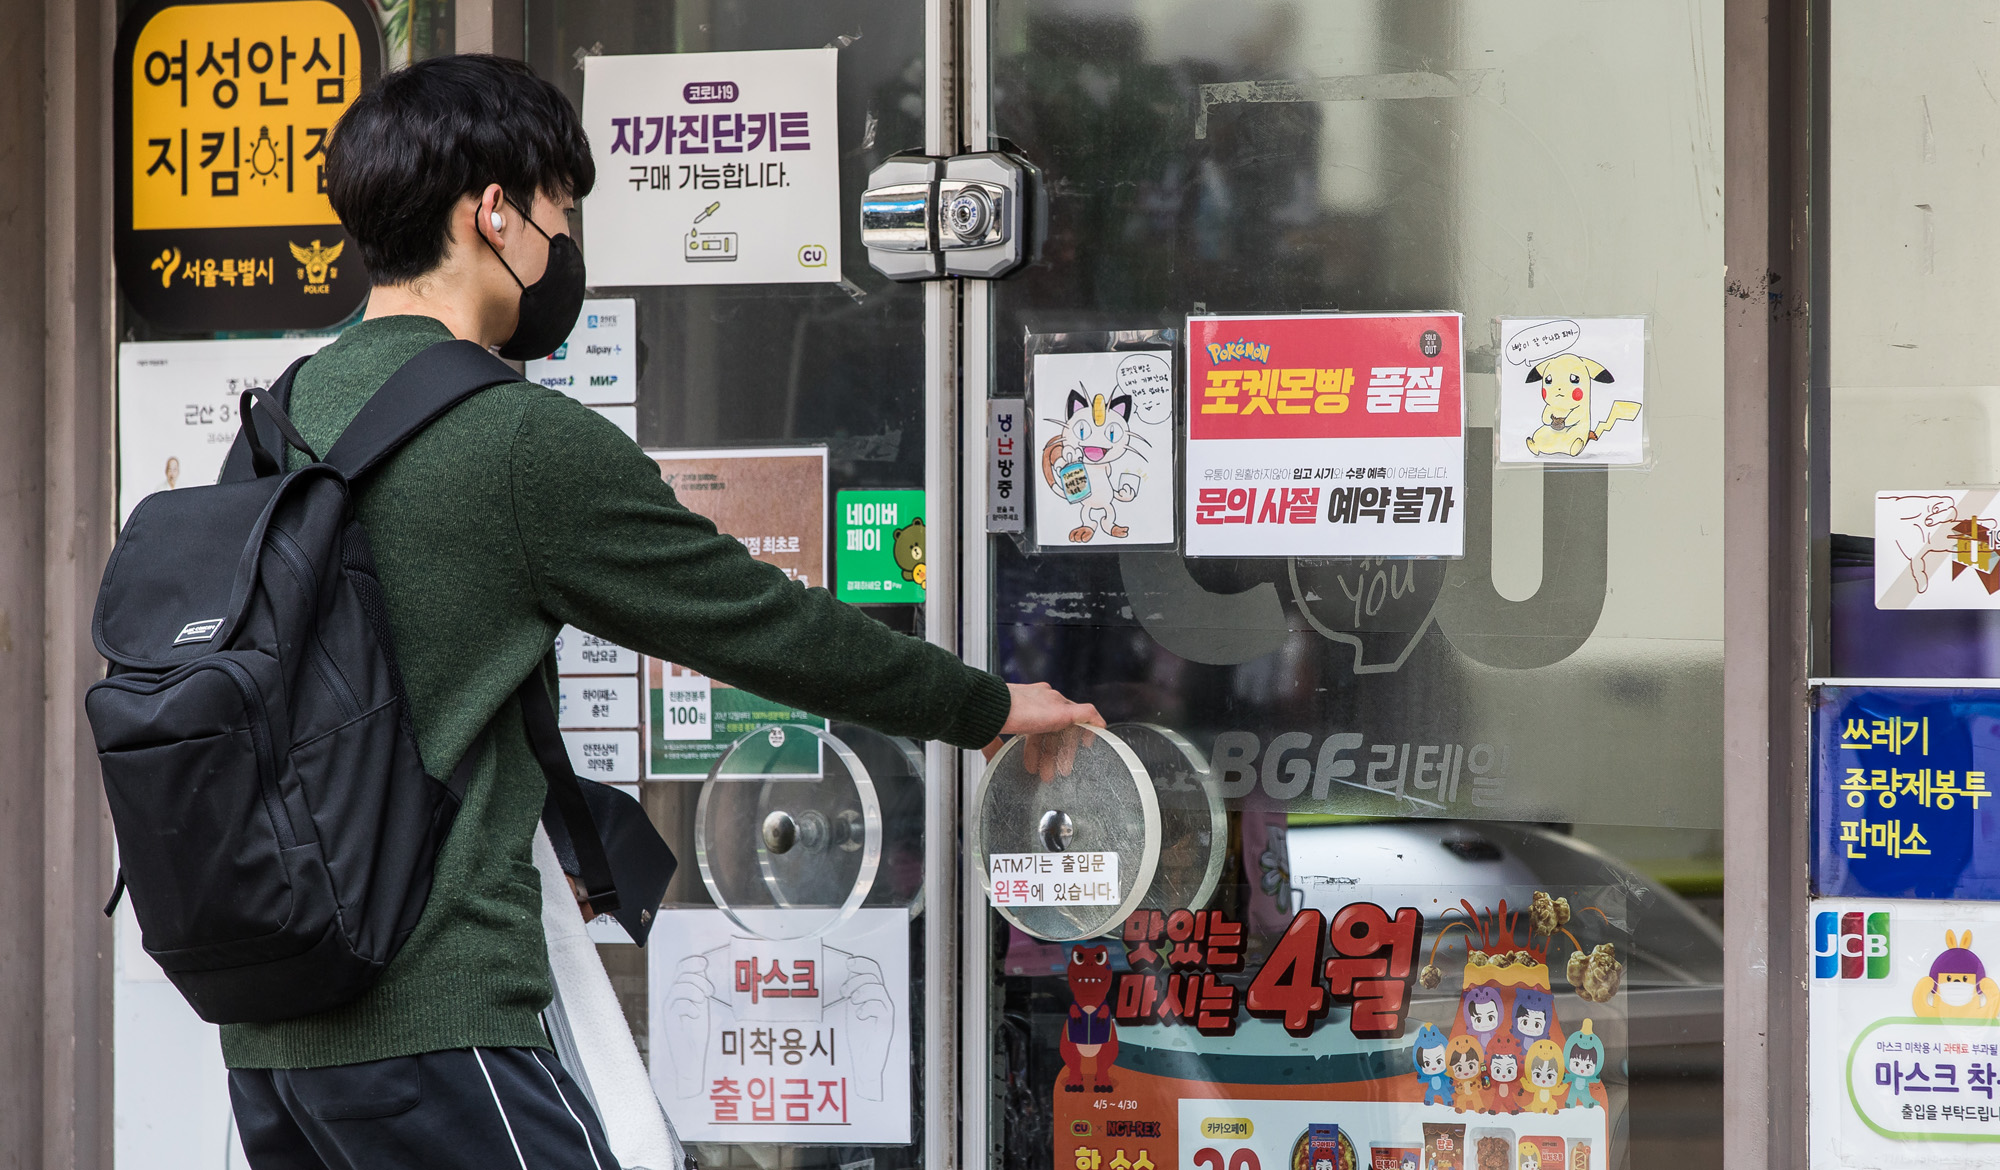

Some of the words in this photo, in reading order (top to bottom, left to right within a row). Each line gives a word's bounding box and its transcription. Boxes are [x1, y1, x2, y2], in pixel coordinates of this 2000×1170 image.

[145, 33, 345, 109] 여성안심
[689, 85, 735, 100] 코로나19
[611, 112, 811, 155] 자가진단키트
[629, 165, 671, 191] 구매
[679, 162, 790, 190] 가능합니다.
[803, 250, 822, 262] CU
[182, 257, 274, 288] 서울특별시
[304, 284, 330, 294] POLICE
[1425, 345, 1437, 355] OUT
[1511, 341, 1529, 352] 빵이
[1201, 368, 1355, 415] 포켓몬빵
[1366, 366, 1443, 414] 품절
[1204, 468, 1233, 480] 유통이
[1234, 468, 1291, 480] 원활하지않아
[1293, 468, 1313, 480] 입고
[1314, 468, 1344, 480] 시기와
[1345, 468, 1365, 480] 수량
[1367, 468, 1396, 480] 예측이
[1398, 467, 1448, 479] 어렵습니다.
[847, 503, 897, 526] 네이버
[1196, 488, 1257, 524] 문의
[1257, 487, 1320, 524] 사절
[1328, 487, 1392, 524] 예약
[1393, 487, 1455, 524] 불가
[763, 536, 800, 554] 최초로
[847, 529, 880, 551] 페이
[582, 651, 618, 662] 미납요금
[583, 690, 618, 701] 하이패스
[592, 705, 609, 717] 충전
[669, 706, 706, 725] 100원
[1841, 716, 1928, 755] 쓰레기
[583, 744, 619, 756] 안전상비
[587, 759, 614, 771] 의약품
[1840, 767, 1992, 810] 종량제봉투
[1840, 818, 1931, 858] 판매소
[992, 855, 1053, 874] ATM기는
[1061, 854, 1106, 873] 출입문
[994, 880, 1044, 903] 왼쪽에
[1053, 882, 1115, 902] 있습니다.
[1123, 909, 1242, 965] 맛있는
[1815, 934, 1888, 958] JCB
[1247, 903, 1418, 1032] 4월
[735, 956, 819, 1005] 마스크
[1116, 973, 1234, 1029] 마시는
[721, 1027, 835, 1066] 미착용시
[1876, 1042, 1902, 1053] 마스크
[1905, 1042, 1930, 1054] 미착용
[1933, 1043, 1941, 1053] 시
[1944, 1043, 1969, 1054] 과태료
[1972, 1044, 1998, 1056] 부과될
[1876, 1060, 1960, 1096] 마스크
[1967, 1063, 2000, 1099] 착
[709, 1077, 848, 1123] 출입금지
[1093, 1100, 1108, 1110] 4/5
[1117, 1100, 1138, 1110] 4/30
[1902, 1104, 1937, 1121] 출입을
[1074, 1124, 1089, 1133] CU
[1106, 1120, 1161, 1138] NCT-REX
[1207, 1122, 1248, 1135] 카카오페이
